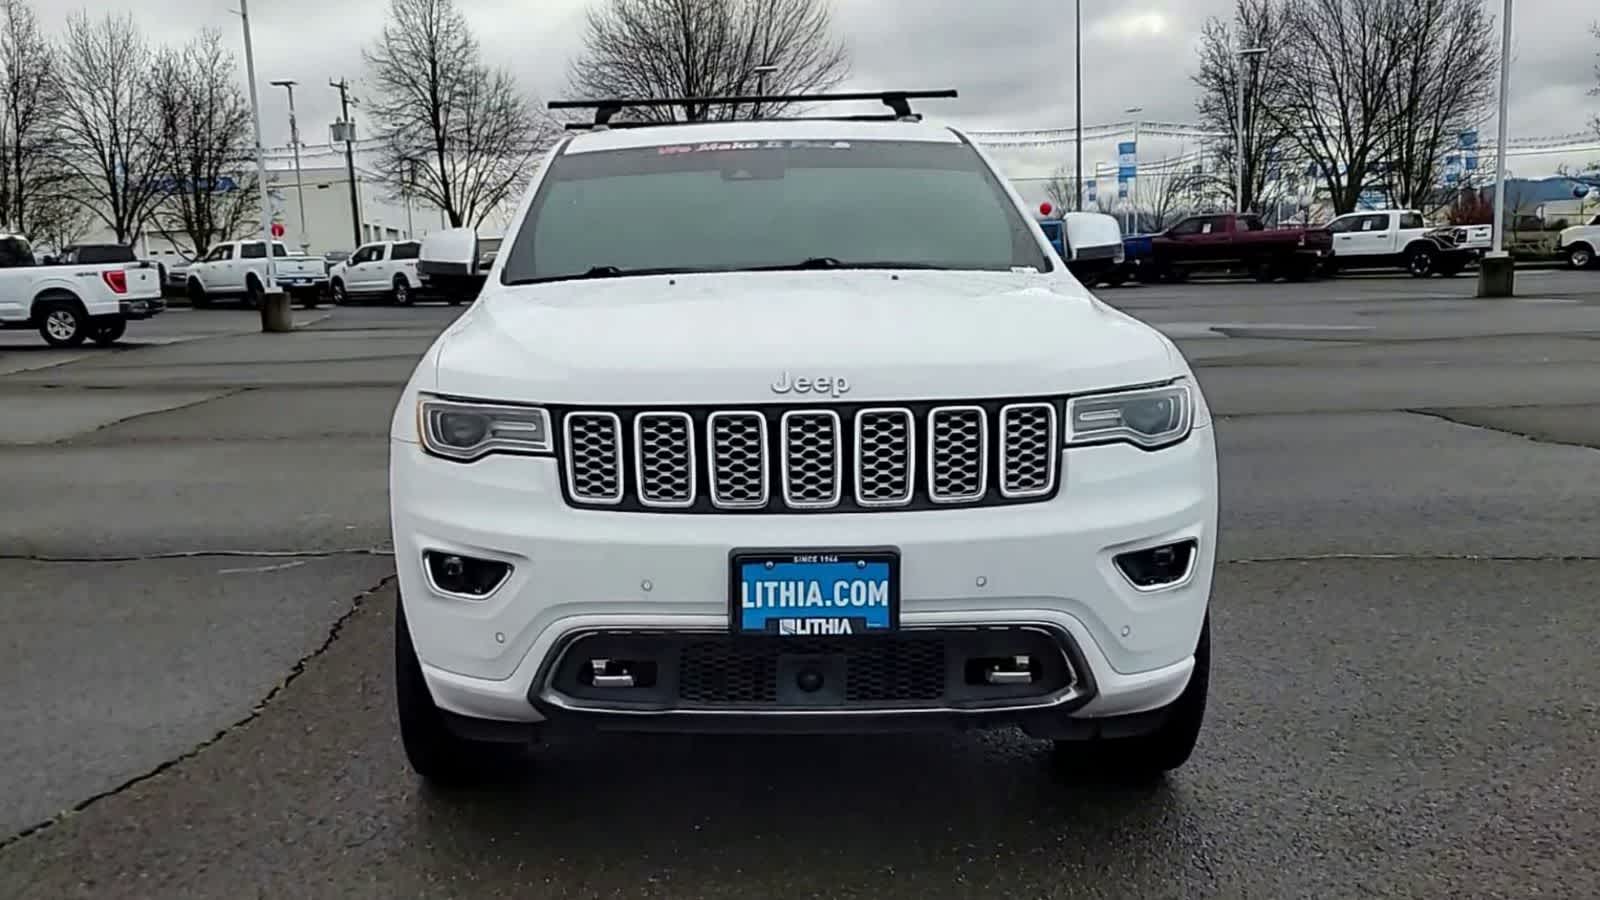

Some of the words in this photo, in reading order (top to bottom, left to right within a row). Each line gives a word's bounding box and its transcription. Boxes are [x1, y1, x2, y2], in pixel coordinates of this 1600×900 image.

[770, 371, 851, 398] Jeep
[793, 555, 818, 563] SINCE
[742, 580, 888, 608] LITHIA.COM
[796, 618, 852, 635] LITHIA
